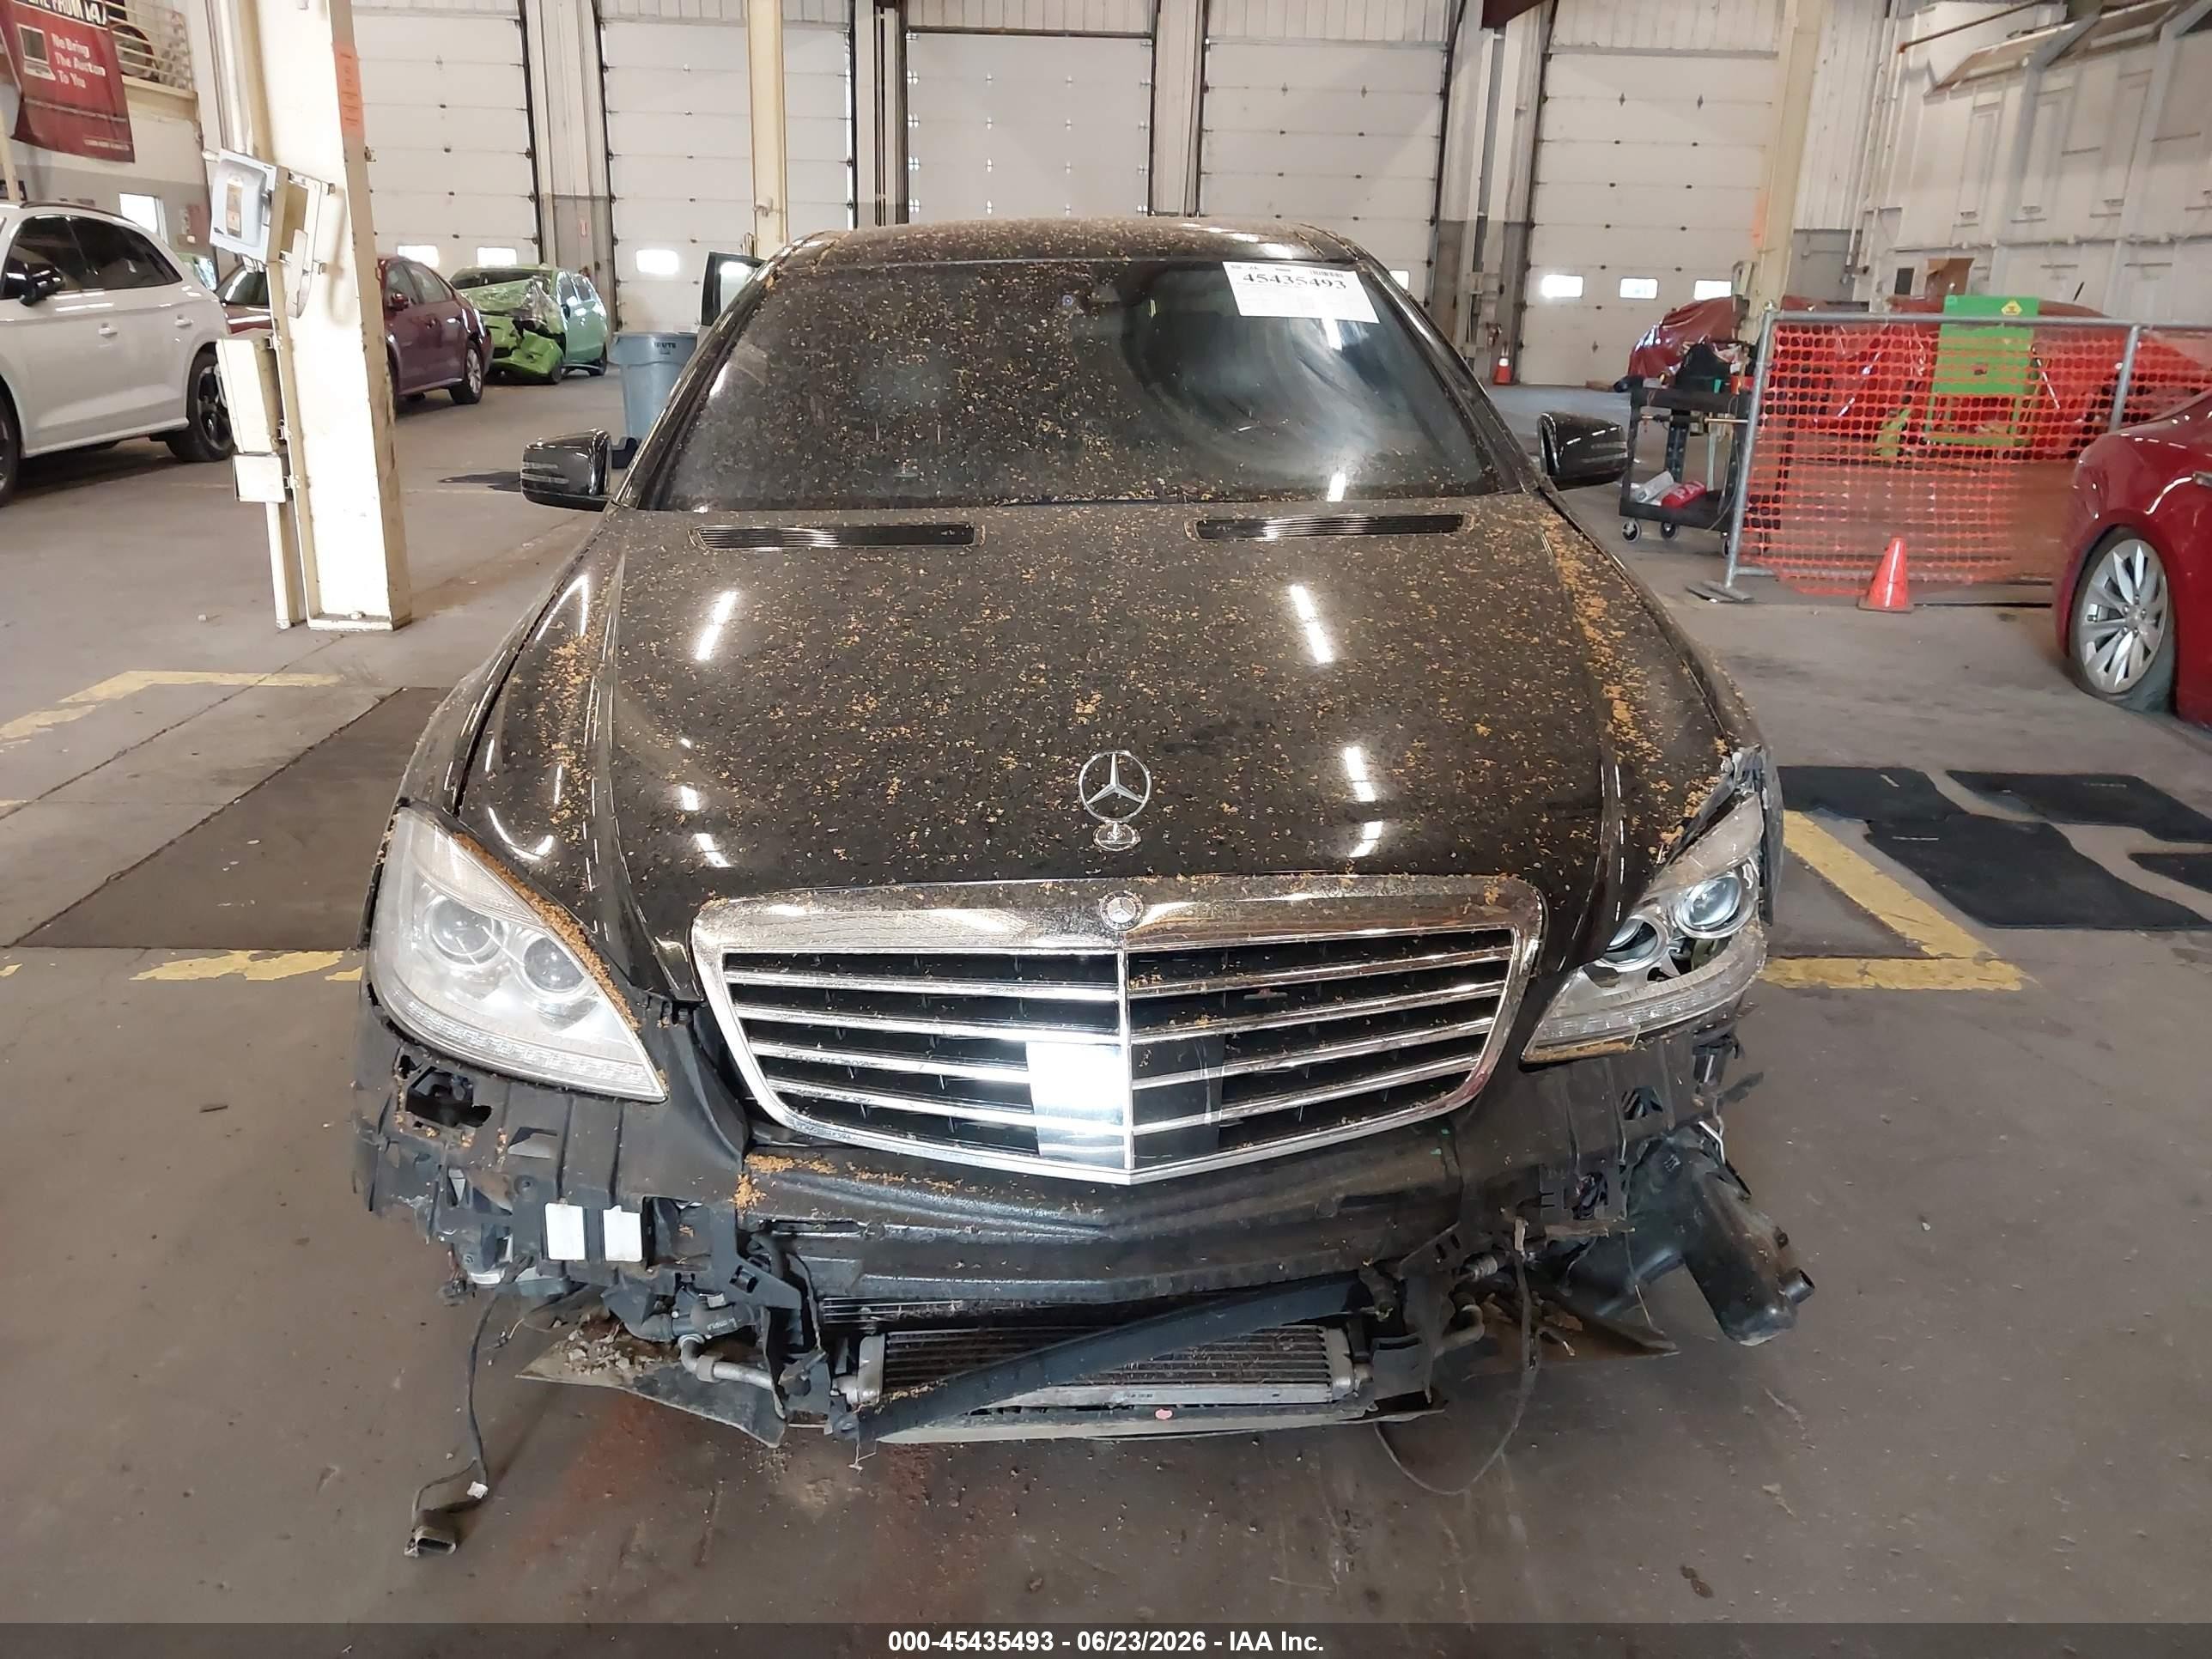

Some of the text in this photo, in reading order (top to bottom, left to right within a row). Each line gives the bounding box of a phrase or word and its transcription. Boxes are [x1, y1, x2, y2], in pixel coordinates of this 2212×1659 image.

[65, 38, 89, 59] Bring
[55, 52, 106, 76] The Auction
[57, 70, 70, 84] To
[1243, 272, 1347, 289] 45435493
